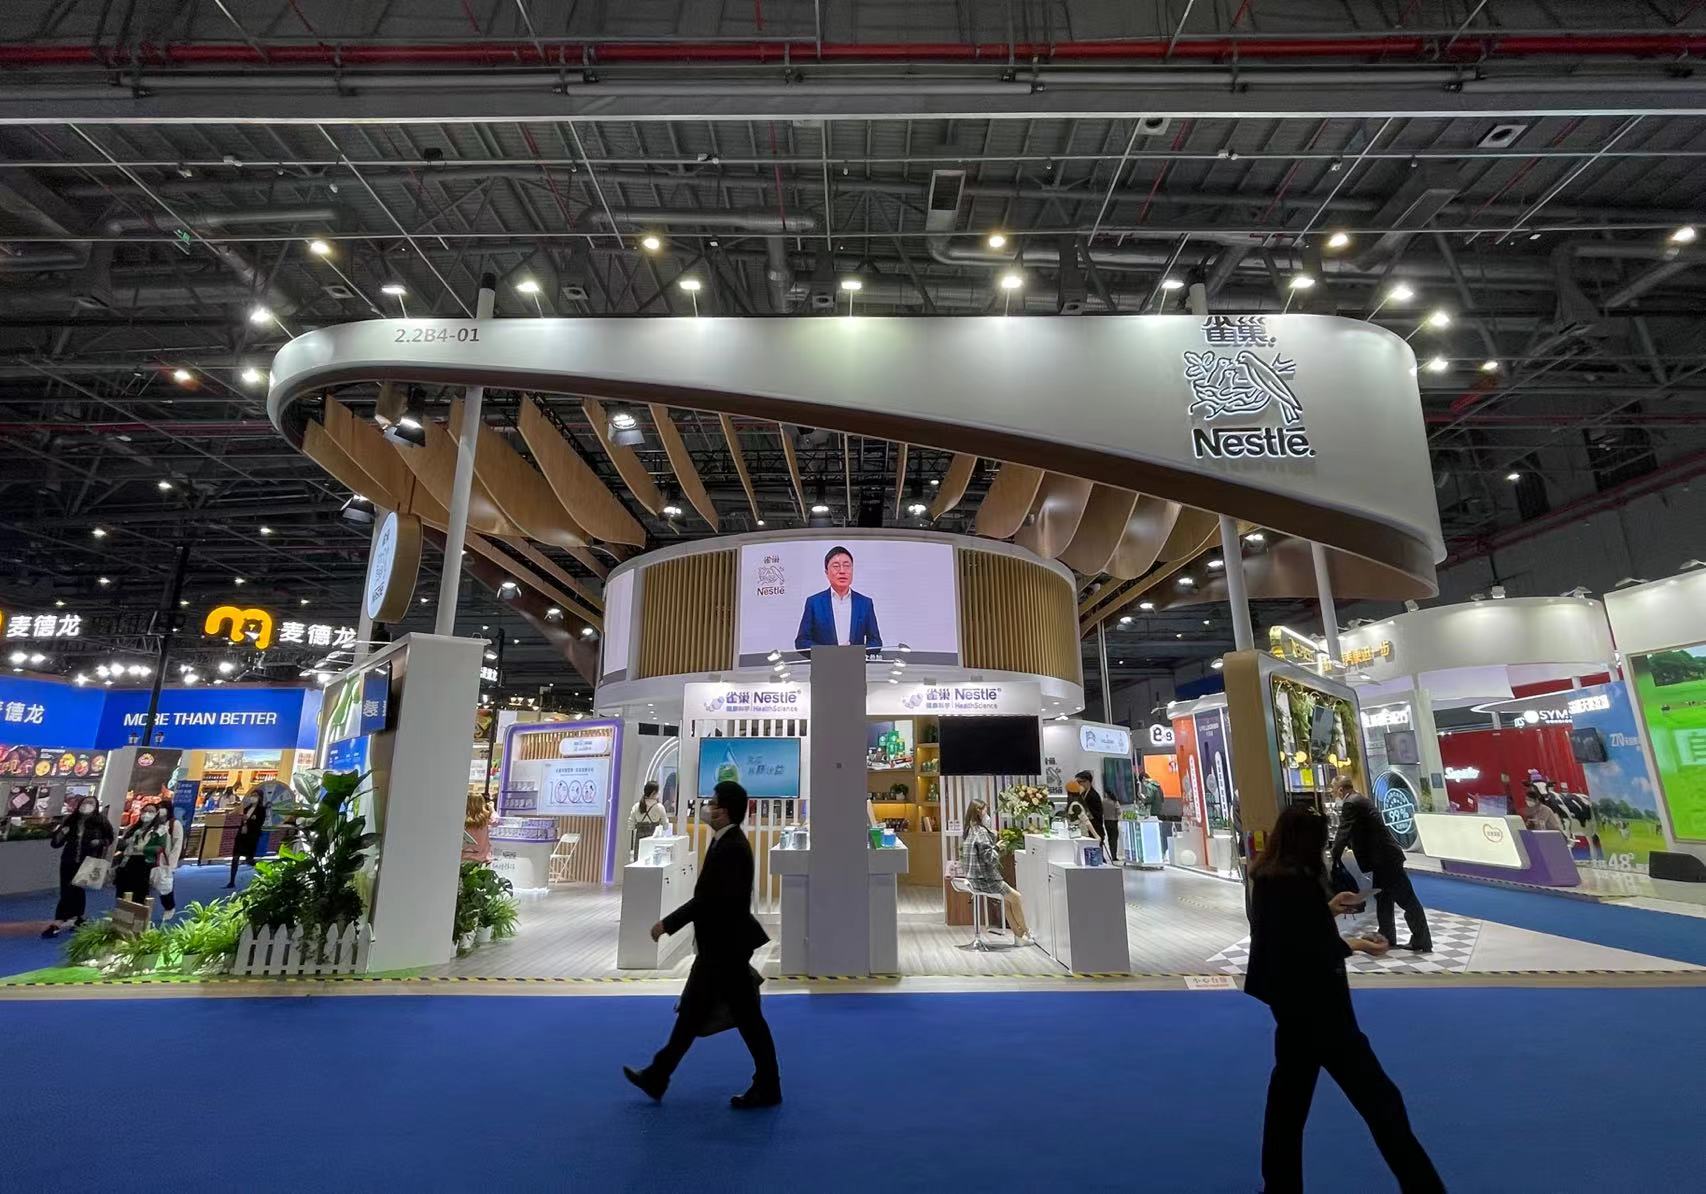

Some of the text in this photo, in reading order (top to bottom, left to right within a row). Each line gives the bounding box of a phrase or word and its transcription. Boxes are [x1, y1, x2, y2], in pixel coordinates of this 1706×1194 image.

[394, 327, 480, 343] 2.2B4-01
[6, 614, 83, 637] 麦德龙
[279, 621, 357, 649] 麦德龙
[725, 690, 751, 704] 雀巢
[926, 687, 951, 701] 雀巢
[0, 701, 45, 724] 德龙
[173, 712, 217, 726] THAN
[219, 711, 278, 726] BETTER
